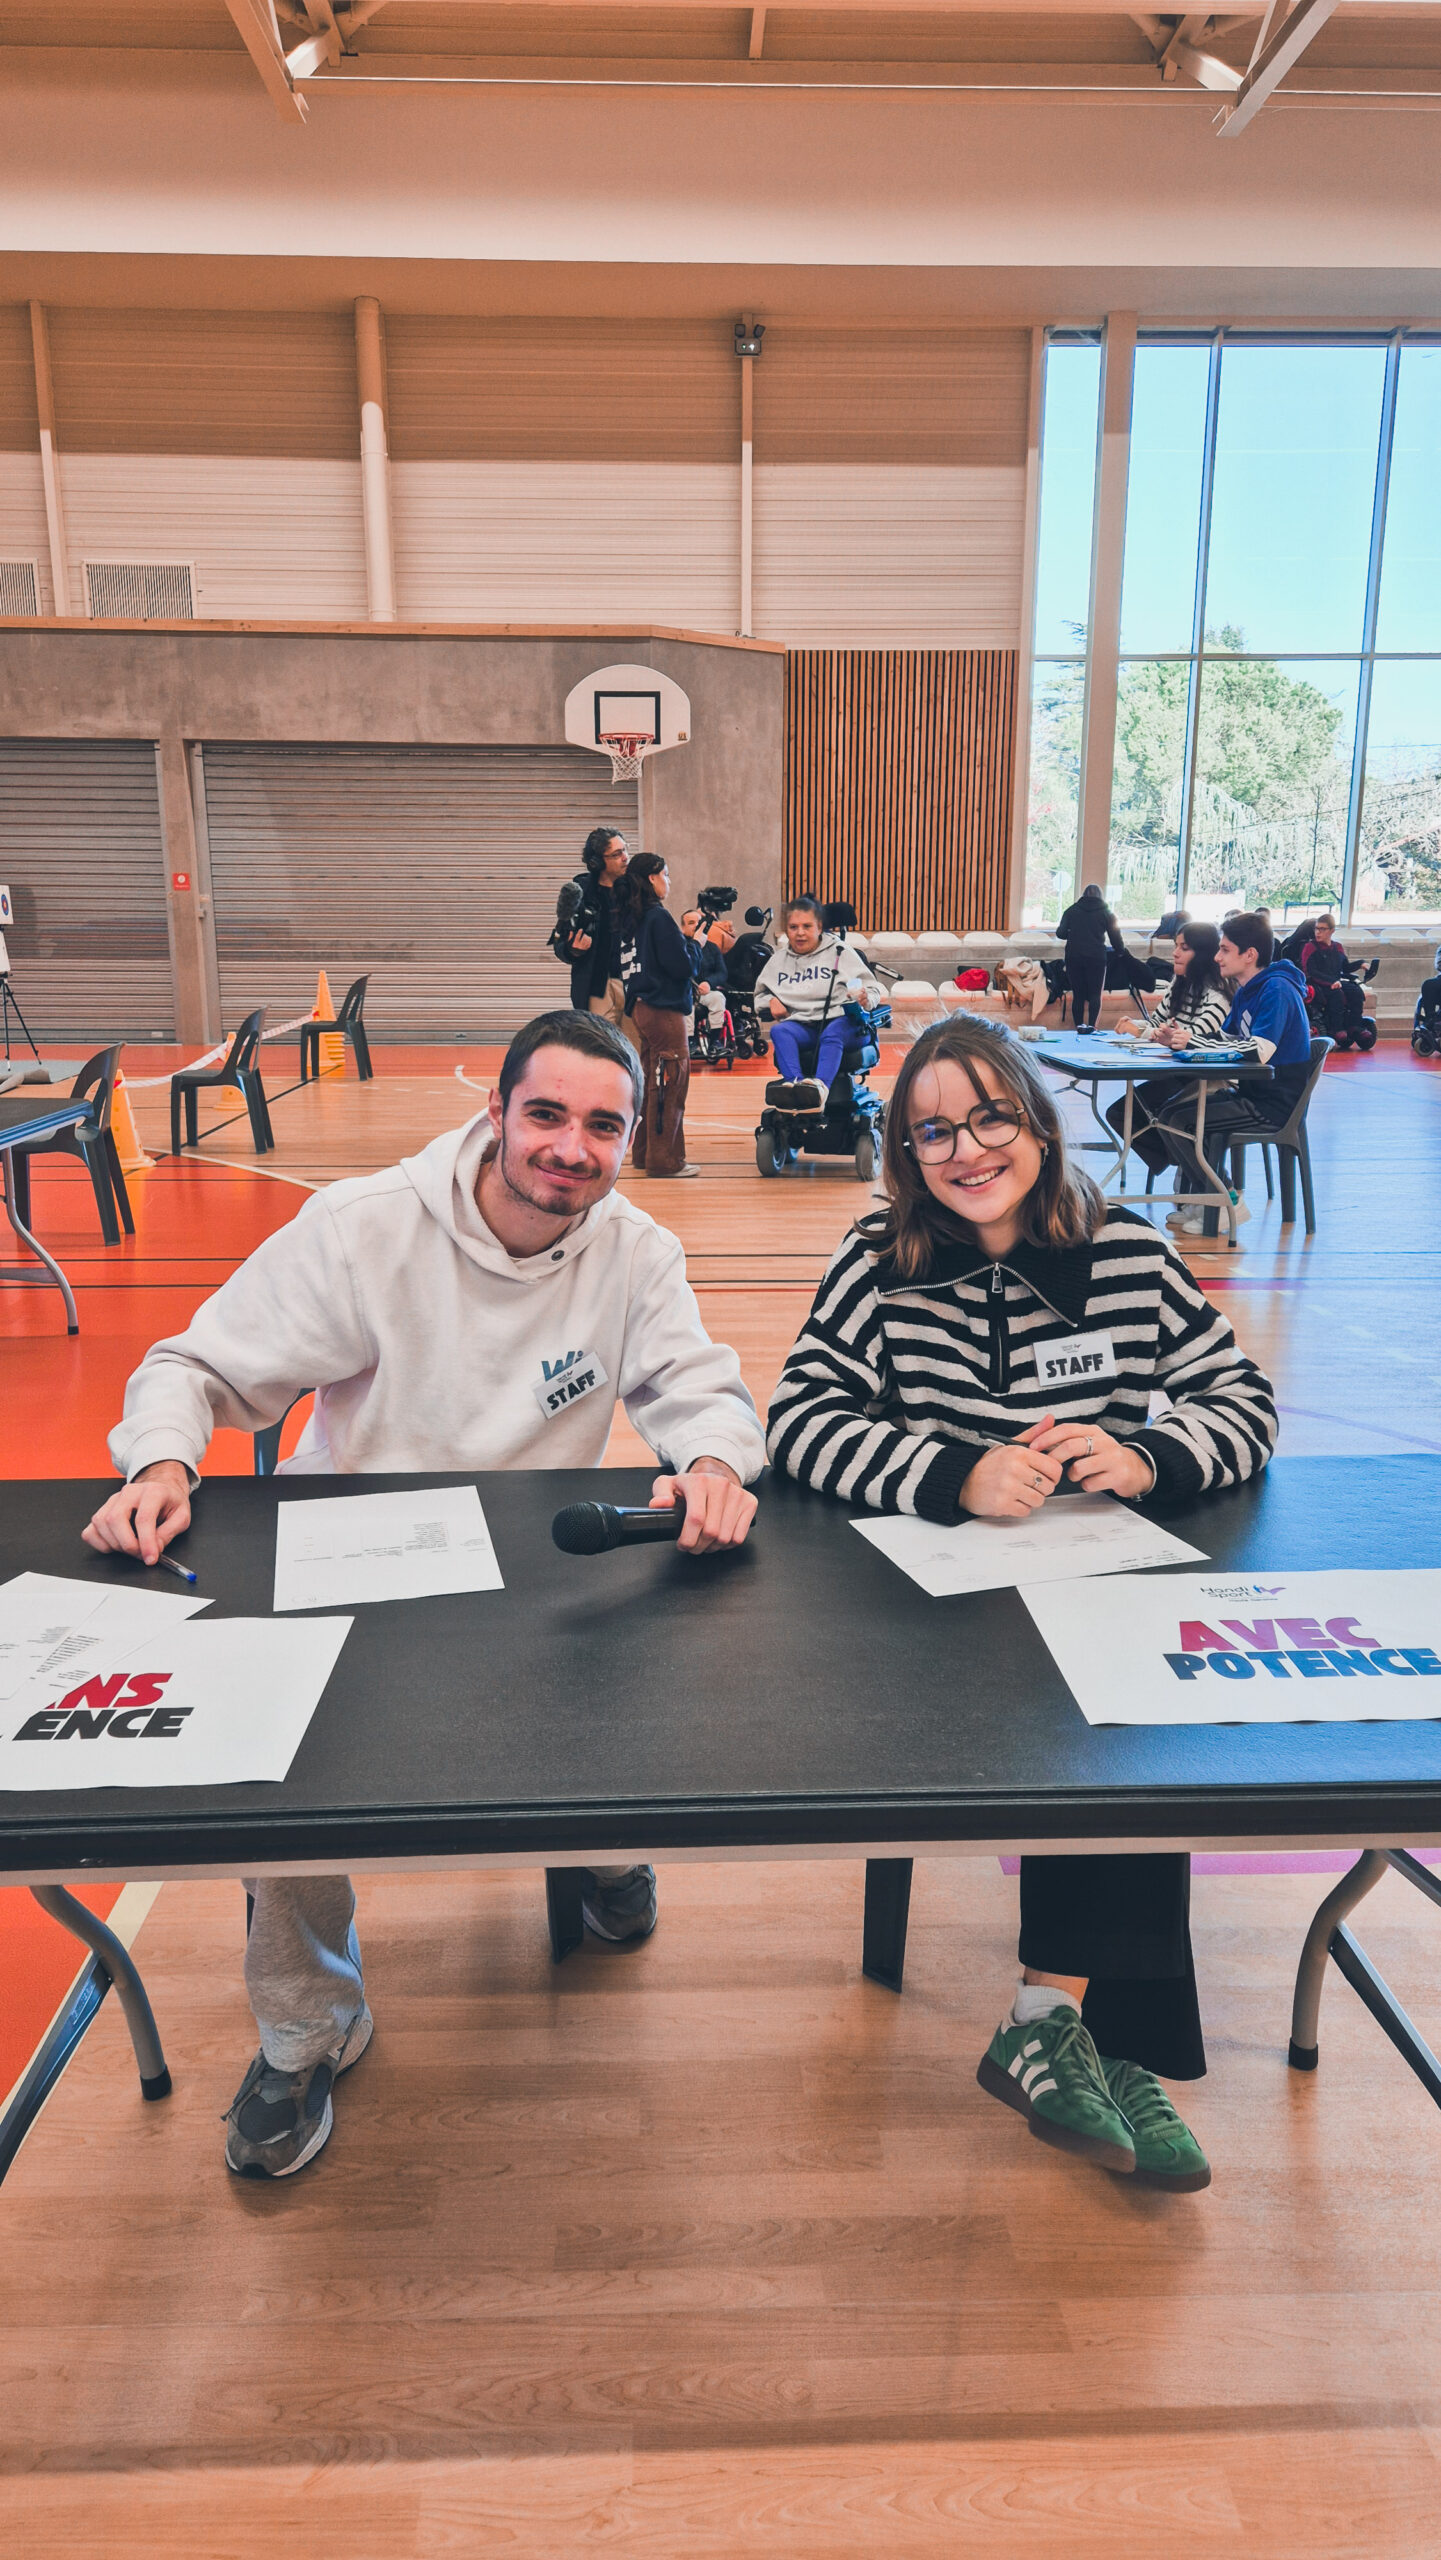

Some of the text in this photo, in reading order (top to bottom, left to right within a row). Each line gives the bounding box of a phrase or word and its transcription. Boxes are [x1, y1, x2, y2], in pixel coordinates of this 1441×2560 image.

[778, 966, 831, 986] PARIS
[1045, 1353, 1104, 1379] STAFF
[546, 1369, 596, 1411] STAFF
[1200, 1585, 1250, 1593] Handi
[1207, 1591, 1253, 1599] Sport
[1179, 1617, 1383, 1652] AVEC
[1162, 1648, 1441, 1681] POTENCE
[44, 1673, 173, 1710] NS
